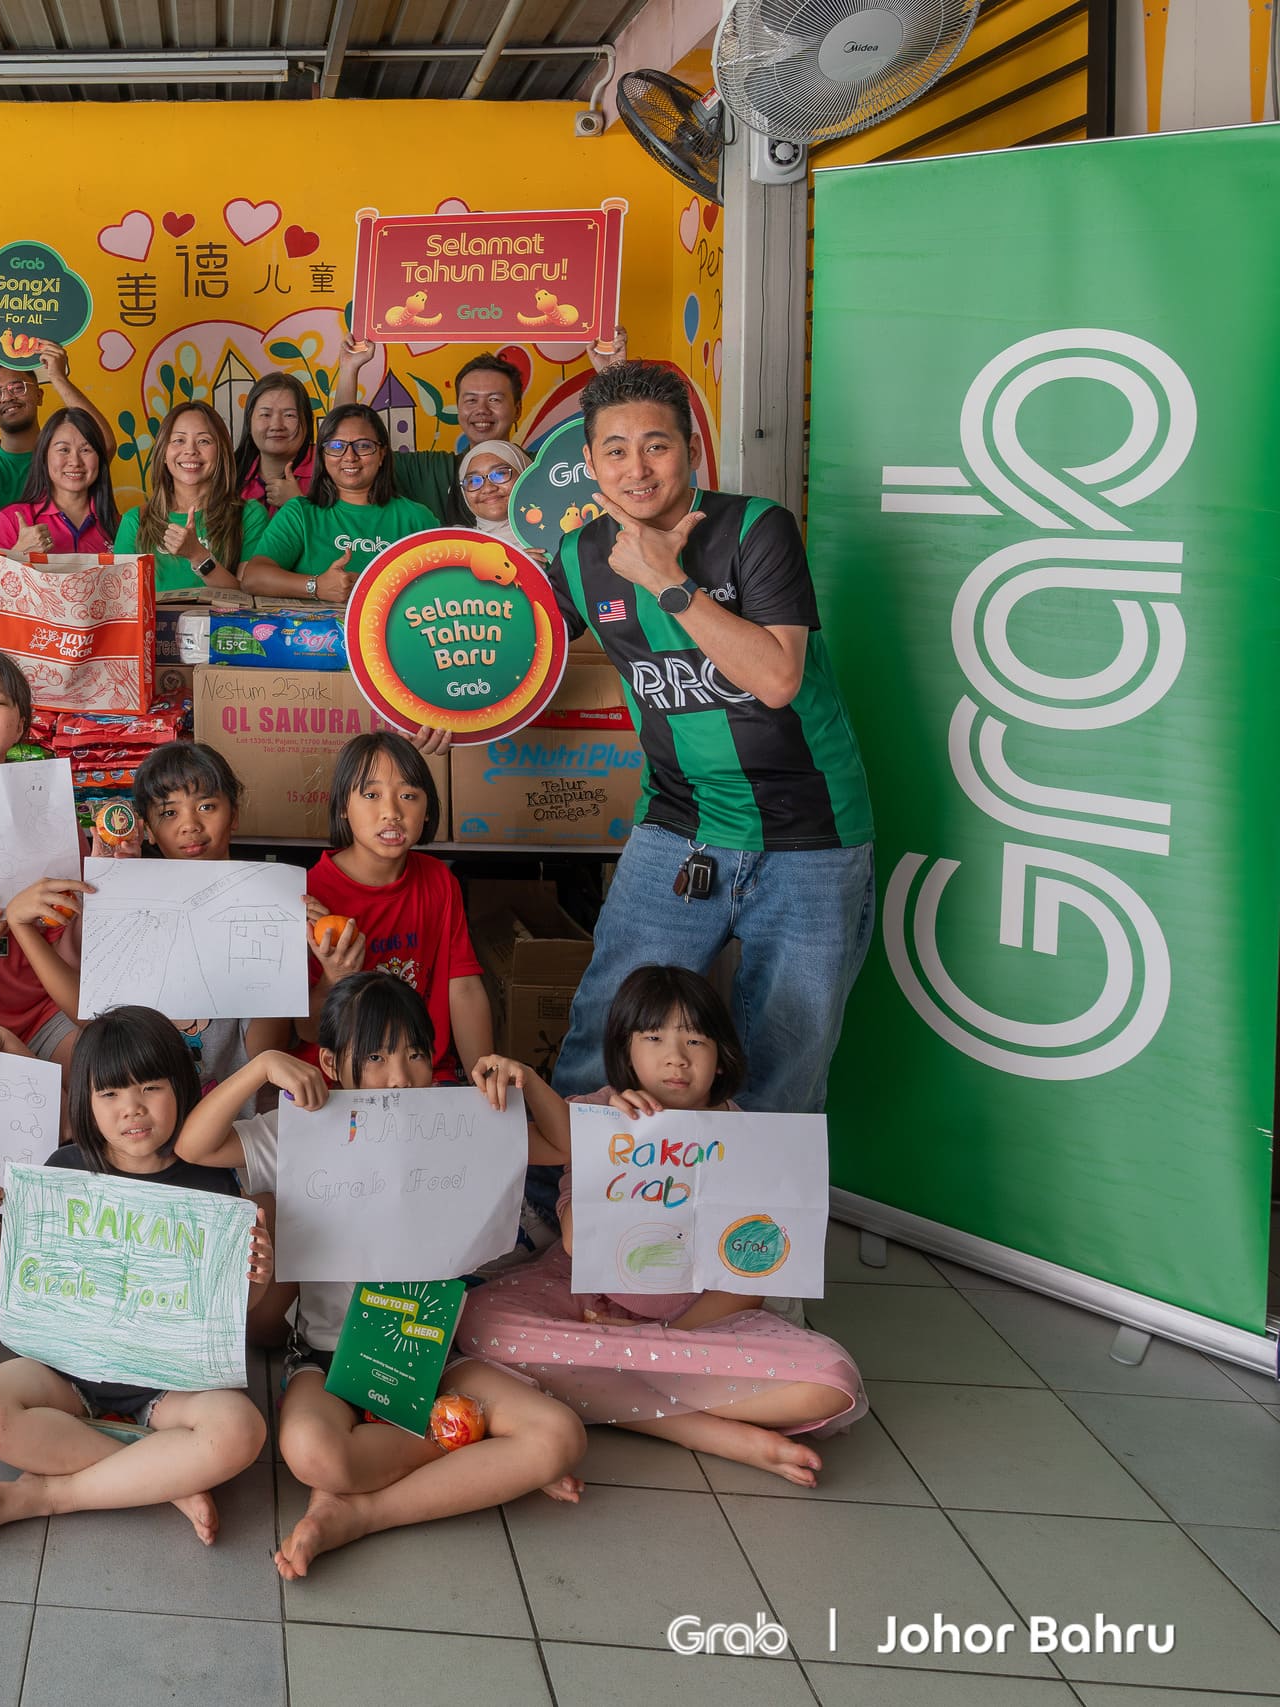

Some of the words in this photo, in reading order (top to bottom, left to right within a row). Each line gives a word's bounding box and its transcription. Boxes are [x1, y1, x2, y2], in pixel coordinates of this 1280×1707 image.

[841, 40, 879, 54] Midea
[426, 231, 545, 260] Selamat
[9, 256, 45, 271] Grab
[401, 258, 485, 284] Tahun
[490, 254, 569, 282] Baru!
[5, 312, 23, 325] For
[25, 313, 43, 325] All
[456, 303, 503, 321] Grab
[334, 534, 392, 553] Grab
[404, 596, 513, 629] Selamat
[55, 631, 95, 648] Jaya
[293, 628, 340, 652] Soft
[420, 620, 502, 648] Tahun
[434, 647, 497, 672] Baru
[201, 674, 267, 701] Nestum
[446, 677, 491, 697] Grab
[880, 327, 1197, 1080] Grab
[222, 705, 251, 734] QL
[259, 706, 362, 734] SAKURA
[526, 787, 608, 808] Kampung
[541, 778, 588, 793] Telur
[533, 803, 601, 822] Omega-3
[340, 1109, 479, 1148] RAKAN
[608, 1133, 725, 1167] Rakan
[305, 1167, 387, 1205] Grab
[406, 1165, 468, 1193] Food
[606, 1172, 691, 1209] Grab
[67, 1198, 206, 1259] RAKAN
[731, 1237, 769, 1254] Grab
[19, 1256, 97, 1298] Grab
[366, 1294, 388, 1307] HOW
[389, 1299, 402, 1309] TO
[402, 1302, 416, 1312] BE
[406, 1326, 414, 1334] A
[414, 1327, 439, 1339] HERO
[367, 1388, 391, 1406] Grab
